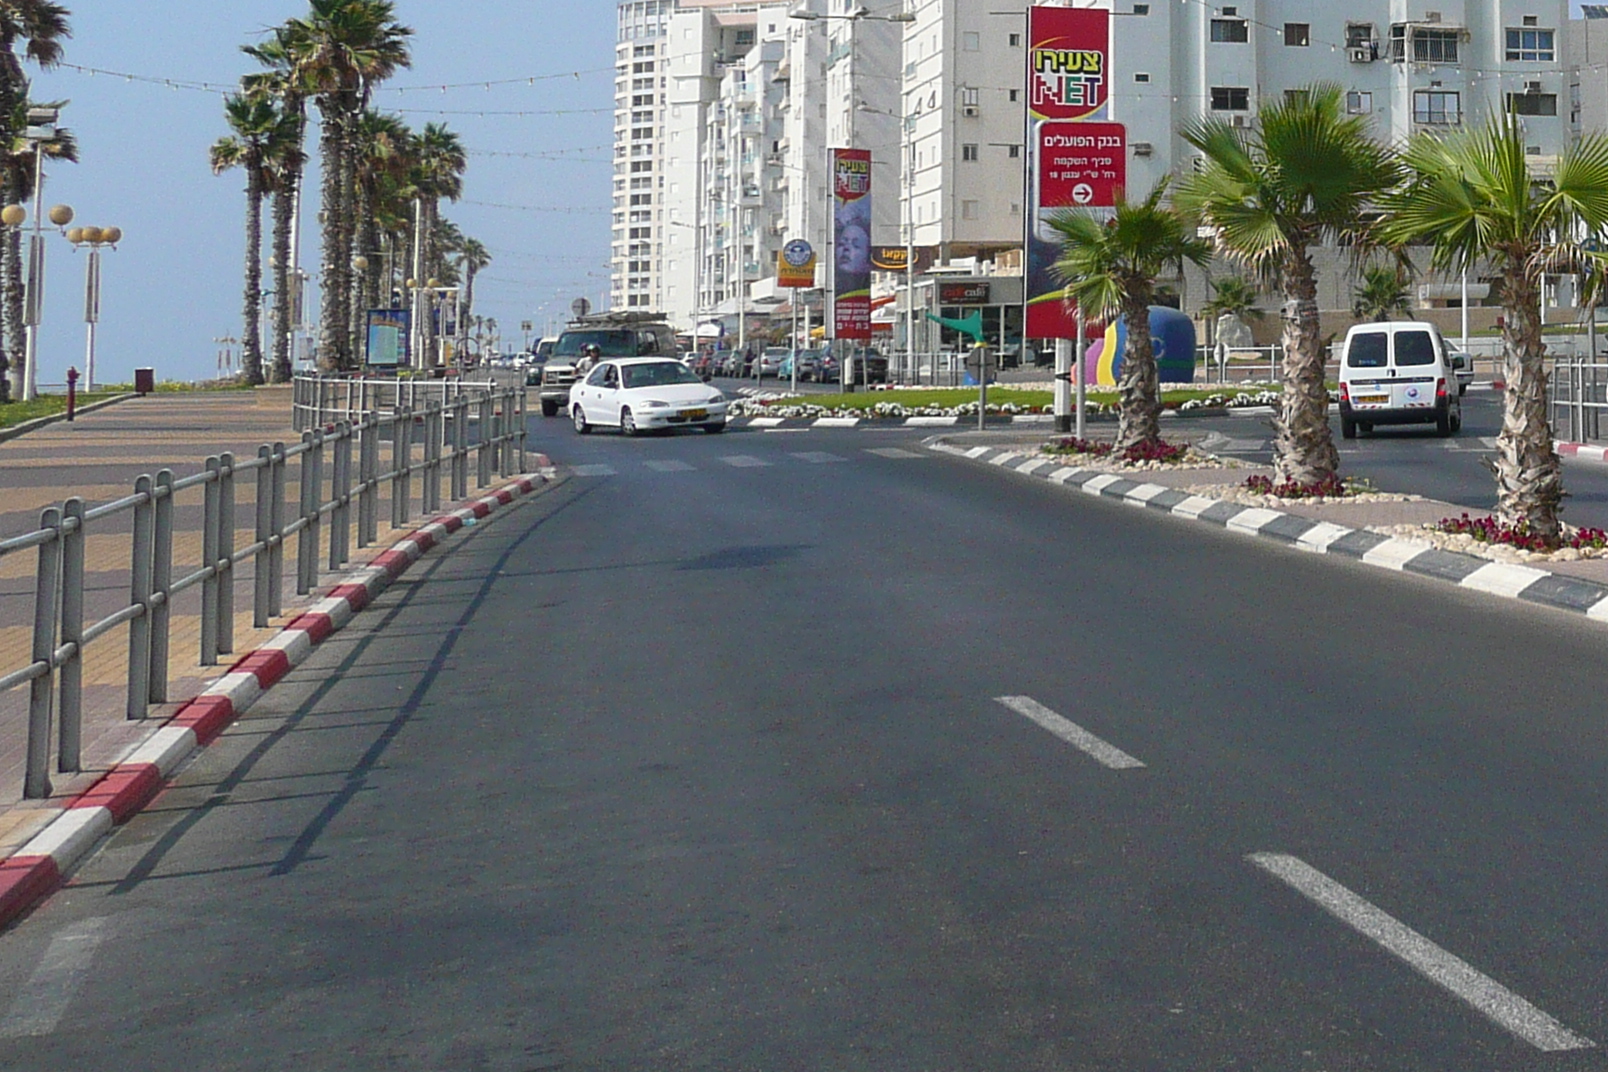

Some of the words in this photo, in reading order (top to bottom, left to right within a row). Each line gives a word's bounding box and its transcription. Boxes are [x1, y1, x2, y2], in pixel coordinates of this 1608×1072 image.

[1033, 74, 1102, 106] NET
[1044, 134, 1095, 147] הפועלים
[1098, 136, 1121, 150] בנק
[1091, 157, 1112, 168] סניף
